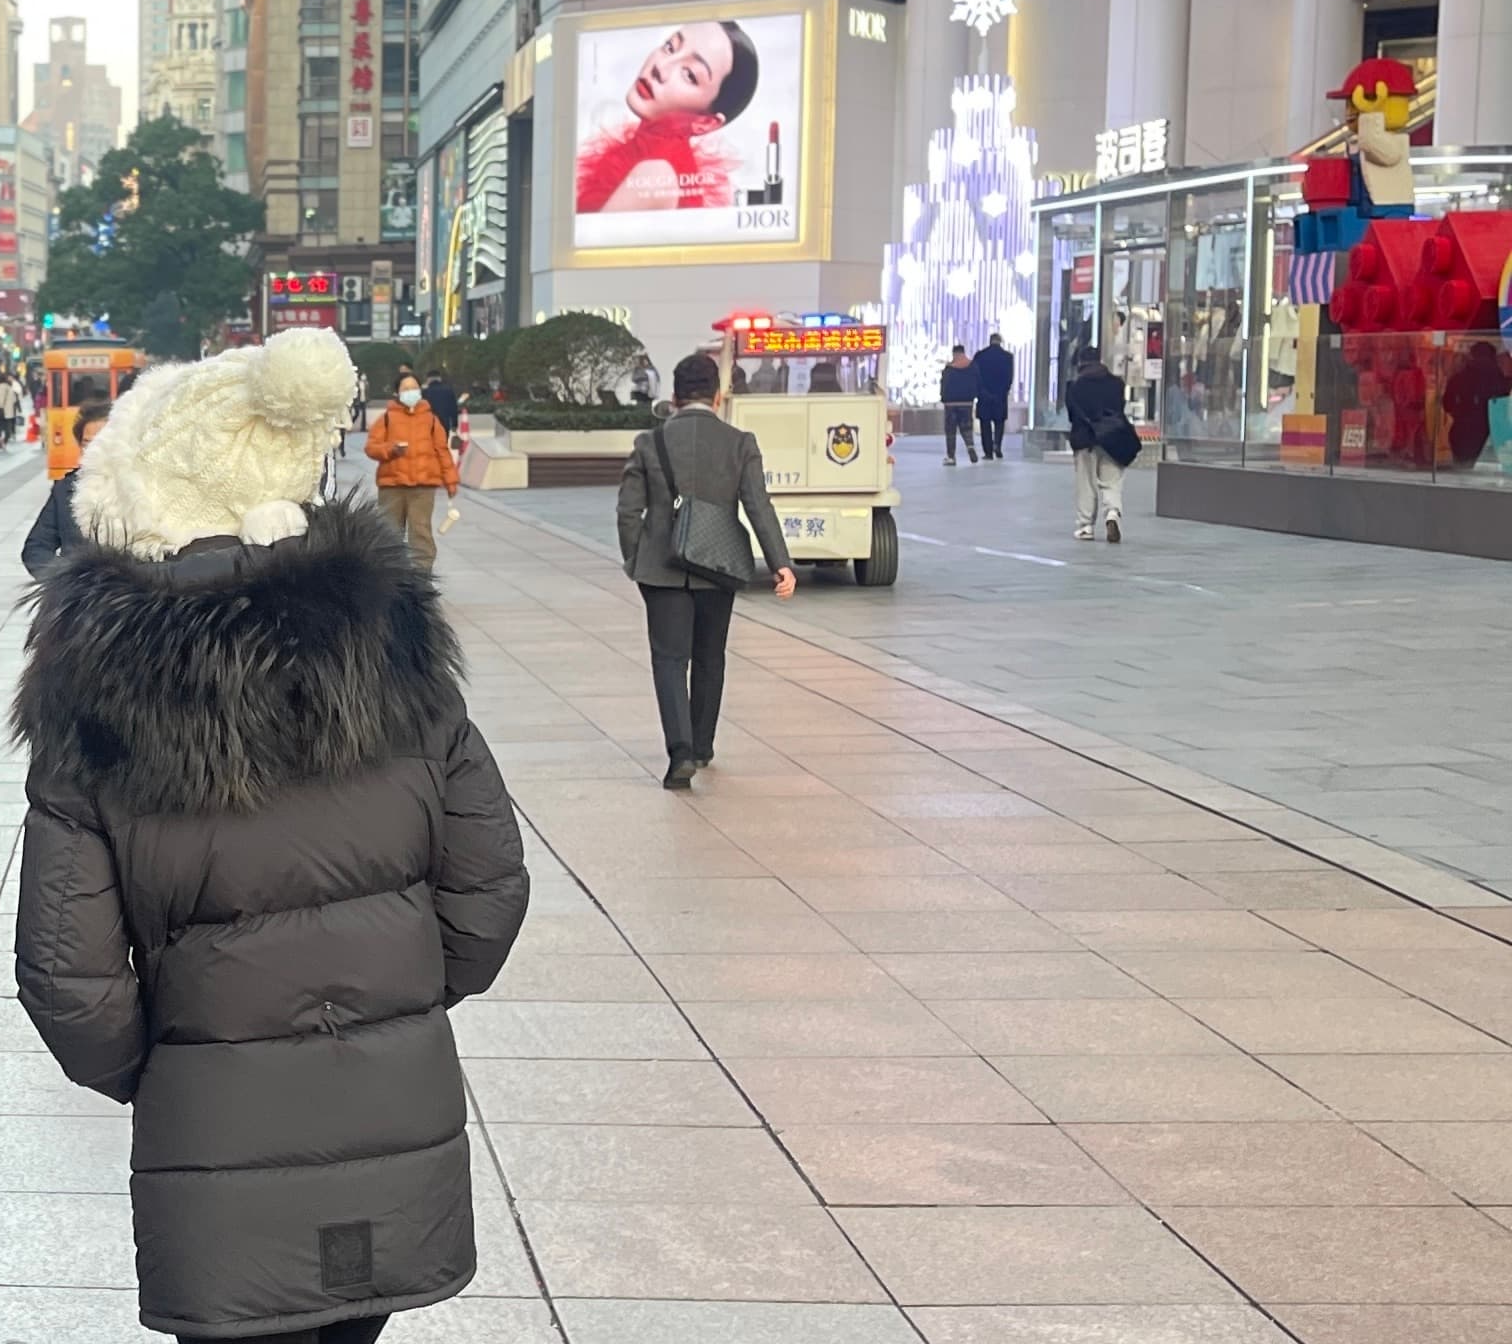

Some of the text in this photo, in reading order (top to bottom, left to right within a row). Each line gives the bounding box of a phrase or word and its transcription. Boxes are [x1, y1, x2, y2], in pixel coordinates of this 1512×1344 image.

[848, 7, 888, 44] DIOR
[1094, 117, 1168, 185] 波司登
[678, 171, 717, 187] DIOR
[737, 208, 791, 230] DIOR
[1340, 423, 1367, 448] LEGO
[782, 517, 826, 538] 警察
